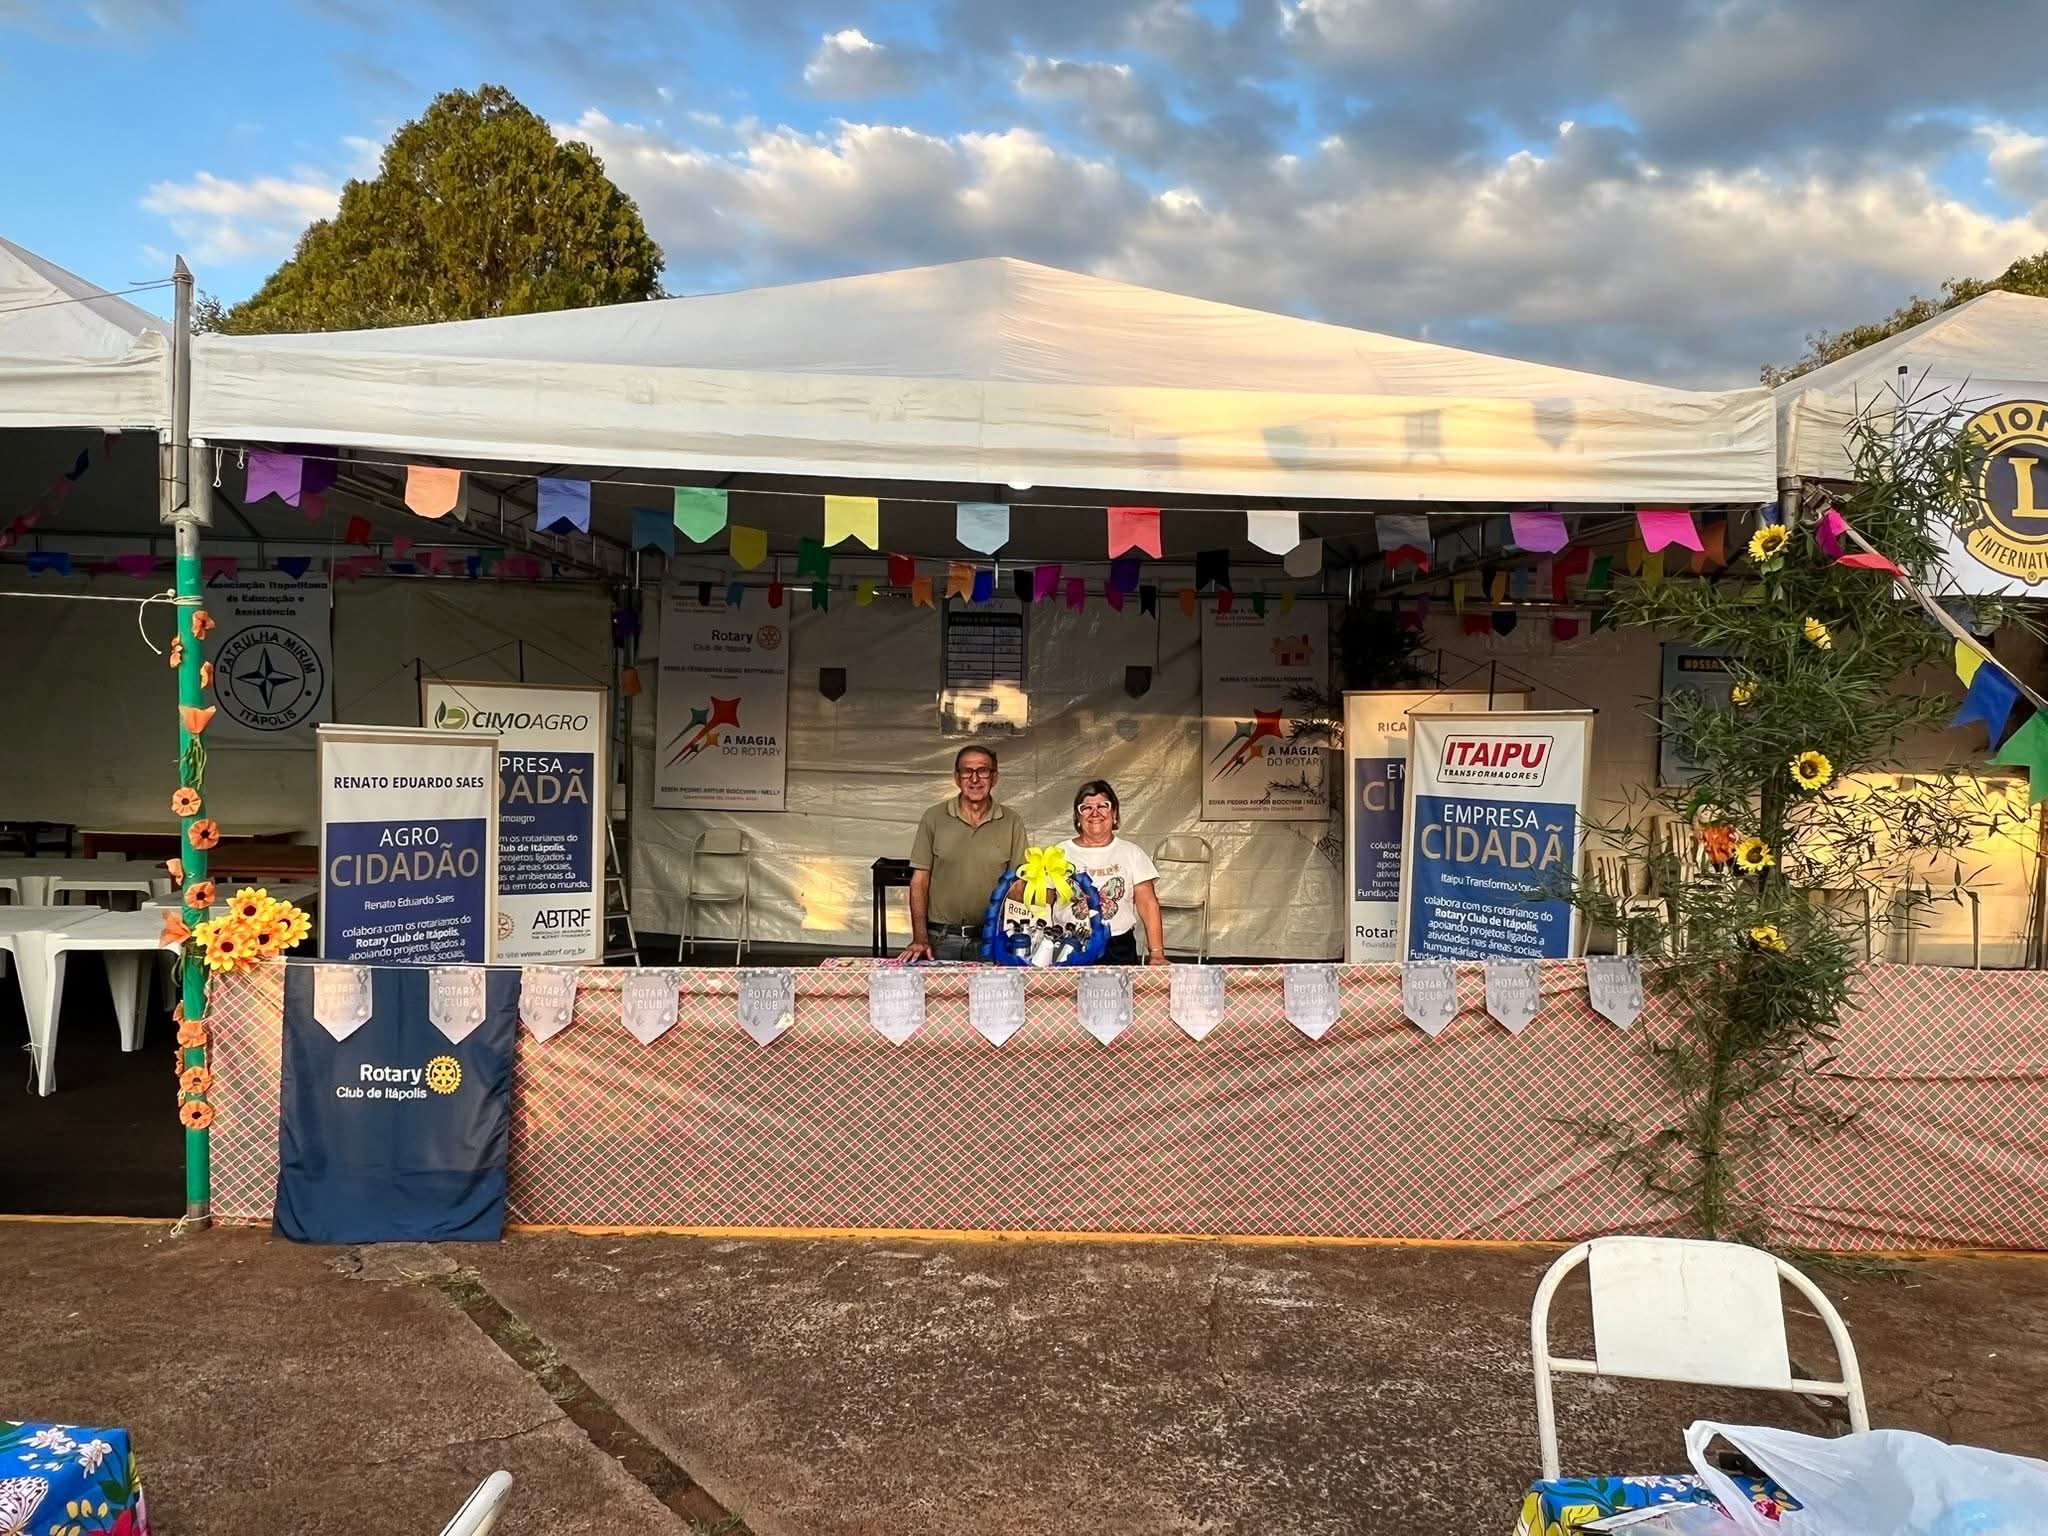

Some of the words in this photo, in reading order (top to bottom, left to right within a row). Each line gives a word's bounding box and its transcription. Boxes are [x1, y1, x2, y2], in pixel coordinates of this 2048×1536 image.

[1976, 534, 2048, 569] INTERNATI
[712, 630, 752, 644] Rotary
[220, 632, 280, 674] PATRULHA
[284, 636, 316, 674] MIRIM
[472, 712, 588, 732] CIMOAGRO
[1378, 722, 1408, 732] RICA
[724, 736, 732, 744] A
[736, 736, 776, 746] MAGIA
[722, 747, 738, 756] DO
[741, 747, 780, 756] ROTARY
[1268, 746, 1276, 756] A
[1280, 746, 1320, 756] MAGIA
[1445, 742, 1546, 768] ITAIPU
[500, 757, 564, 774] PRESA
[1266, 758, 1283, 766] DO
[1286, 758, 1324, 766] ROTARY
[334, 776, 388, 788] RENATO
[392, 776, 452, 788] EDUARDO
[456, 776, 484, 788] SAES
[1444, 769, 1538, 780] TRANSFORMADORES
[500, 768, 588, 804] ADÃ
[500, 814, 536, 824] imoagro
[1444, 804, 1540, 830] EMPRESA
[380, 826, 439, 847] AGRO
[500, 844, 516, 852] lub
[518, 844, 529, 852] de
[1382, 850, 1400, 859] Rot
[1421, 823, 1564, 871] CIDADÃ
[330, 842, 480, 887] CIDADÃO
[512, 882, 527, 890] em
[528, 880, 548, 890] todo
[1440, 872, 1464, 886] Itaipu
[364, 900, 396, 910] Renato
[398, 896, 434, 908] Eduardo
[436, 894, 454, 904] Saes
[1424, 896, 1460, 910] colabora
[1462, 900, 1480, 911] com
[1482, 902, 1493, 912] os
[1494, 905, 1540, 920] rotarianos
[1540, 911, 1553, 922] do
[532, 908, 591, 930] ABTRF
[1435, 908, 1466, 924] Rotary
[1467, 912, 1488, 924] Club
[1489, 914, 1502, 926] de
[342, 925, 382, 938] colabora
[384, 924, 404, 934] com
[406, 922, 416, 931] os
[418, 916, 460, 930] rotarianos
[460, 914, 472, 924] do
[1356, 925, 1398, 938] Rotar
[1428, 920, 1468, 936] apoiando
[1470, 924, 1505, 940] projetos
[1506, 930, 1538, 945] ligados
[1539, 937, 1545, 946] a
[356, 934, 388, 949] Rotary
[390, 932, 411, 944] Club
[412, 930, 424, 942] de
[1428, 930, 1470, 946] atividades
[1472, 937, 1487, 948] nas
[1488, 938, 1512, 952] áreas
[394, 942, 430, 958] projetos
[430, 938, 458, 952] ligados
[460, 938, 466, 946] a
[1424, 941, 1479, 958] humanitárias
[530, 985, 566, 996] ROTARY
[1412, 980, 1448, 990] ROTARY
[1494, 978, 1530, 988] ROTARY
[438, 986, 477, 997] ROTARY
[632, 988, 670, 999] ROTARY
[749, 990, 784, 1000] ROTARY
[754, 1000, 778, 1010] CLUB
[360, 1064, 422, 1086] Rotary
[336, 1086, 364, 1098] Club
[366, 1087, 382, 1098] de
[385, 1086, 427, 1102] Itápolis
